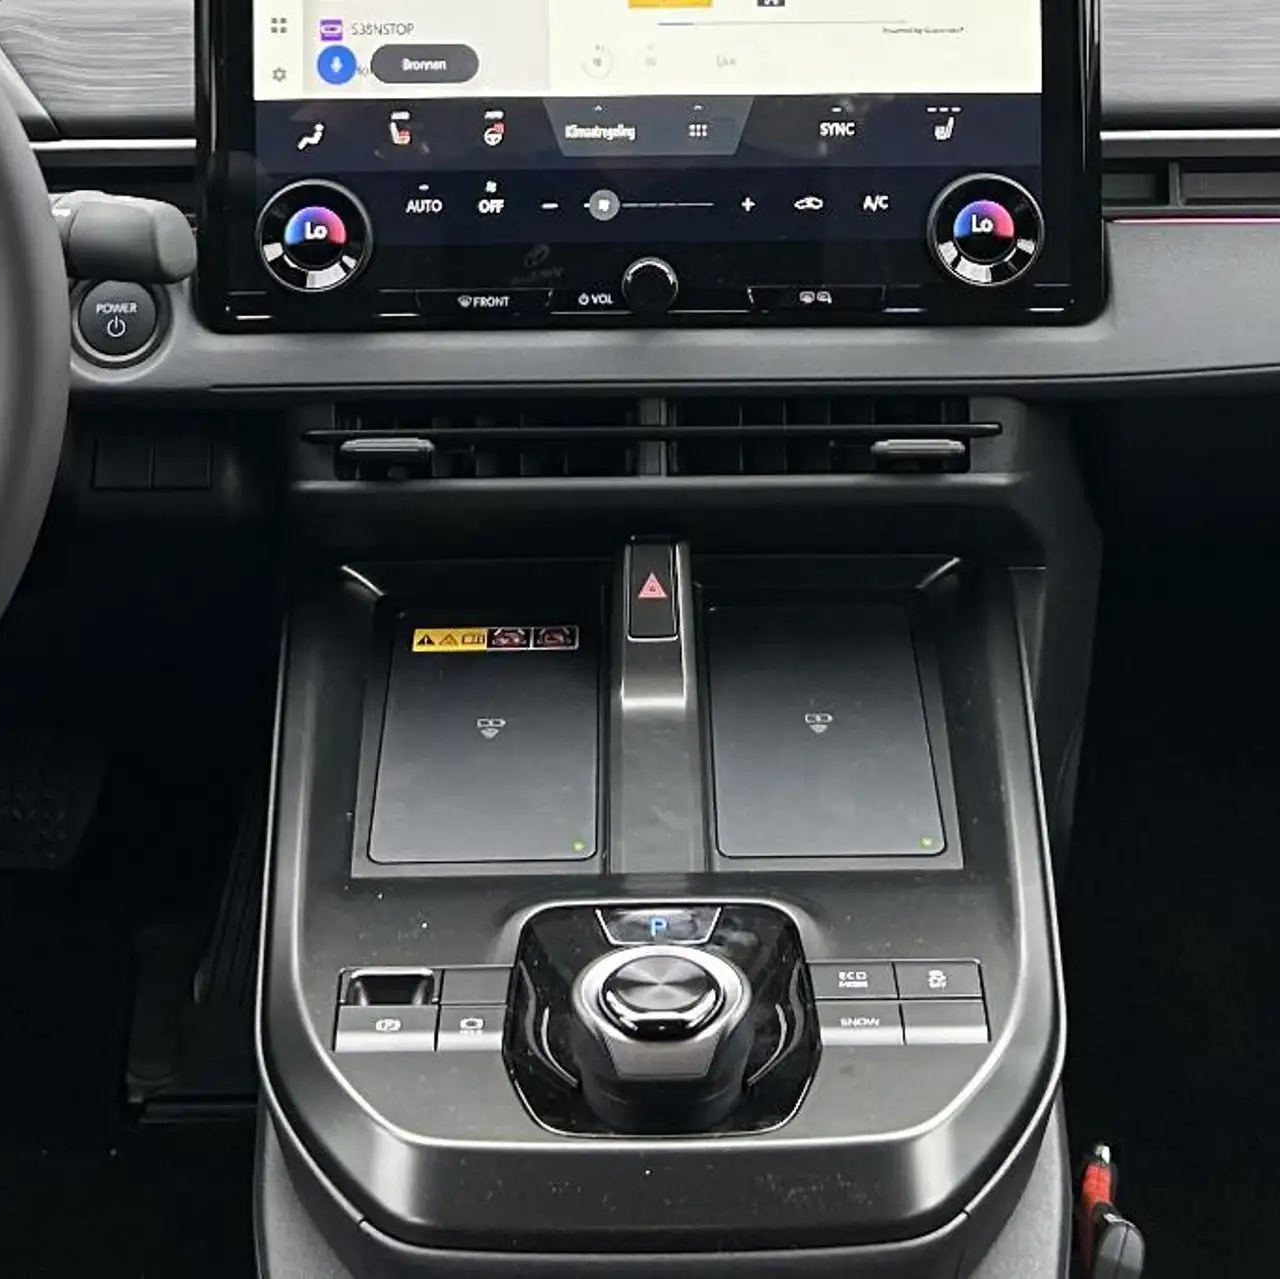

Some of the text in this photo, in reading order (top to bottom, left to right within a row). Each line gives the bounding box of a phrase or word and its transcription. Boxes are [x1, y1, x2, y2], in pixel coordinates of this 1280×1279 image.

[402, 58, 447, 71] Bronnen
[820, 122, 855, 137] SYNC
[405, 199, 443, 213] AUTO
[478, 198, 505, 213] OFF
[863, 195, 889, 211] A/C
[305, 221, 328, 240] Lo
[971, 214, 994, 233] Lo
[473, 295, 509, 308] FRONT
[592, 293, 613, 305] VOL
[96, 302, 137, 314] POWER
[649, 916, 667, 937] P
[838, 972, 867, 980] ECO
[840, 1017, 881, 1027] SNOW
